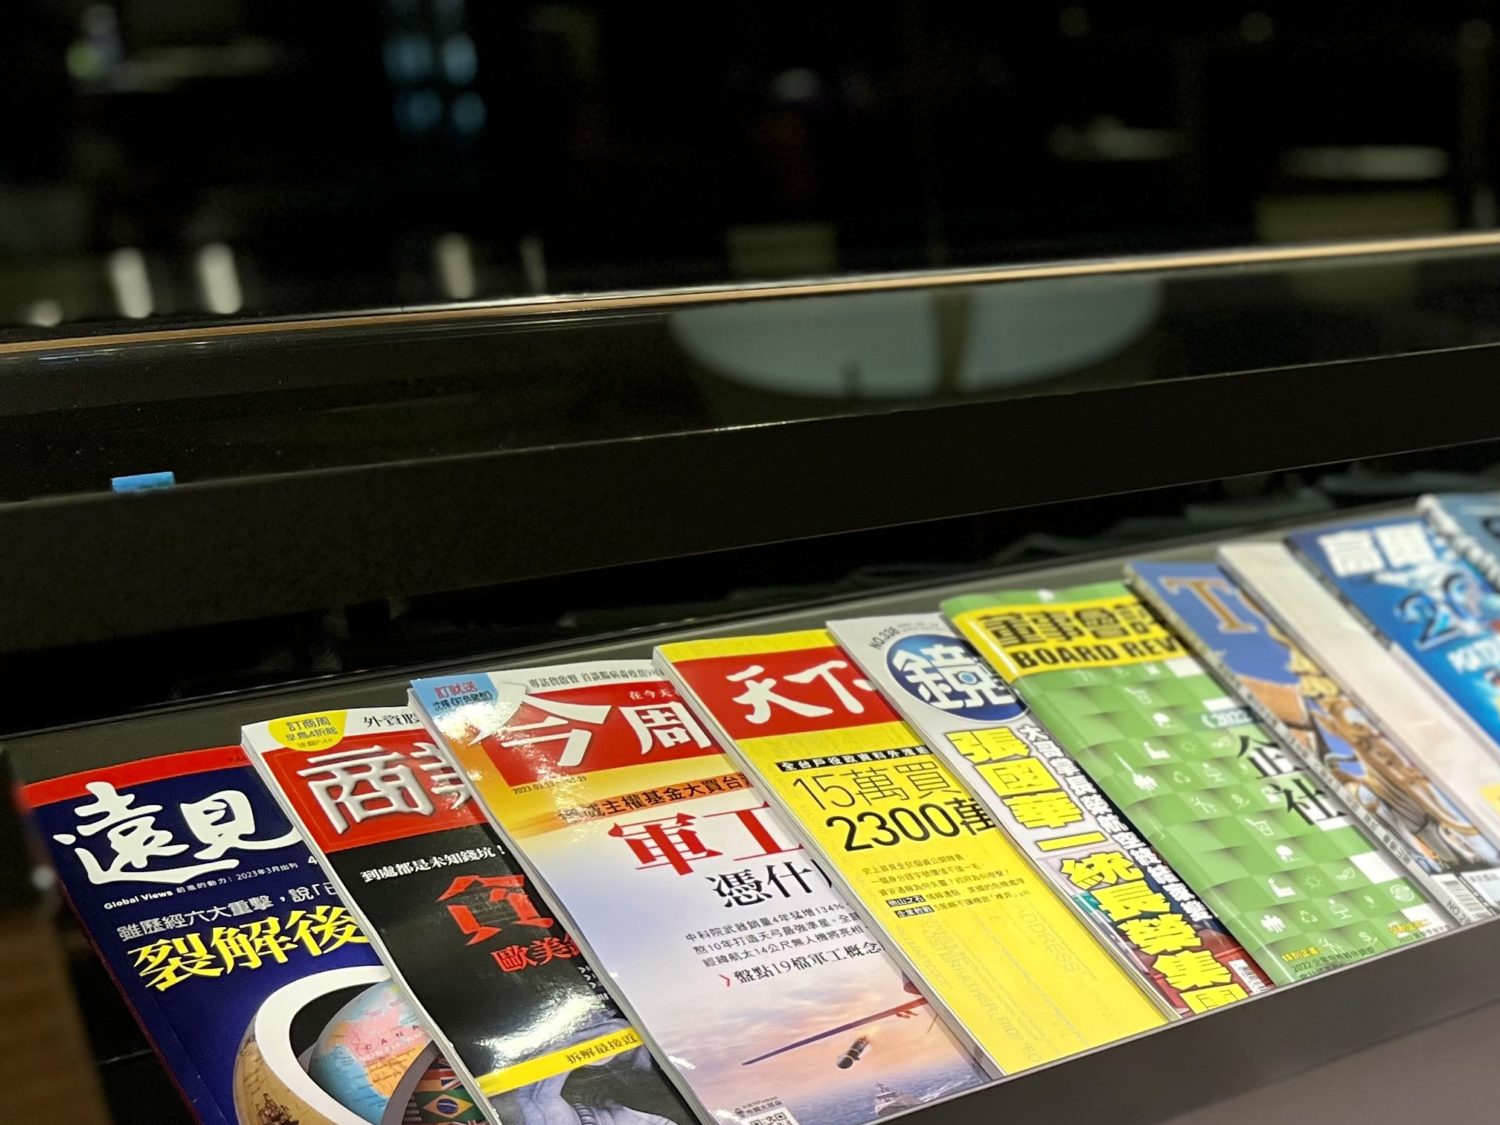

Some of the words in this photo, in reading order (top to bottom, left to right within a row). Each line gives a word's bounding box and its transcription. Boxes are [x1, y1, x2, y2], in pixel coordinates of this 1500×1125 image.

[892, 643, 1018, 709] 鏡
[1012, 645, 1119, 668] BOARD
[468, 680, 712, 768] 今周
[793, 760, 961, 811] 15萬買
[53, 781, 303, 885] 遠見
[608, 801, 804, 876] 軍工
[826, 796, 996, 852] 2300萬
[104, 893, 140, 910] Global
[141, 889, 173, 902] Views
[705, 858, 834, 908] 憑什
[127, 905, 370, 991] 裂解後
